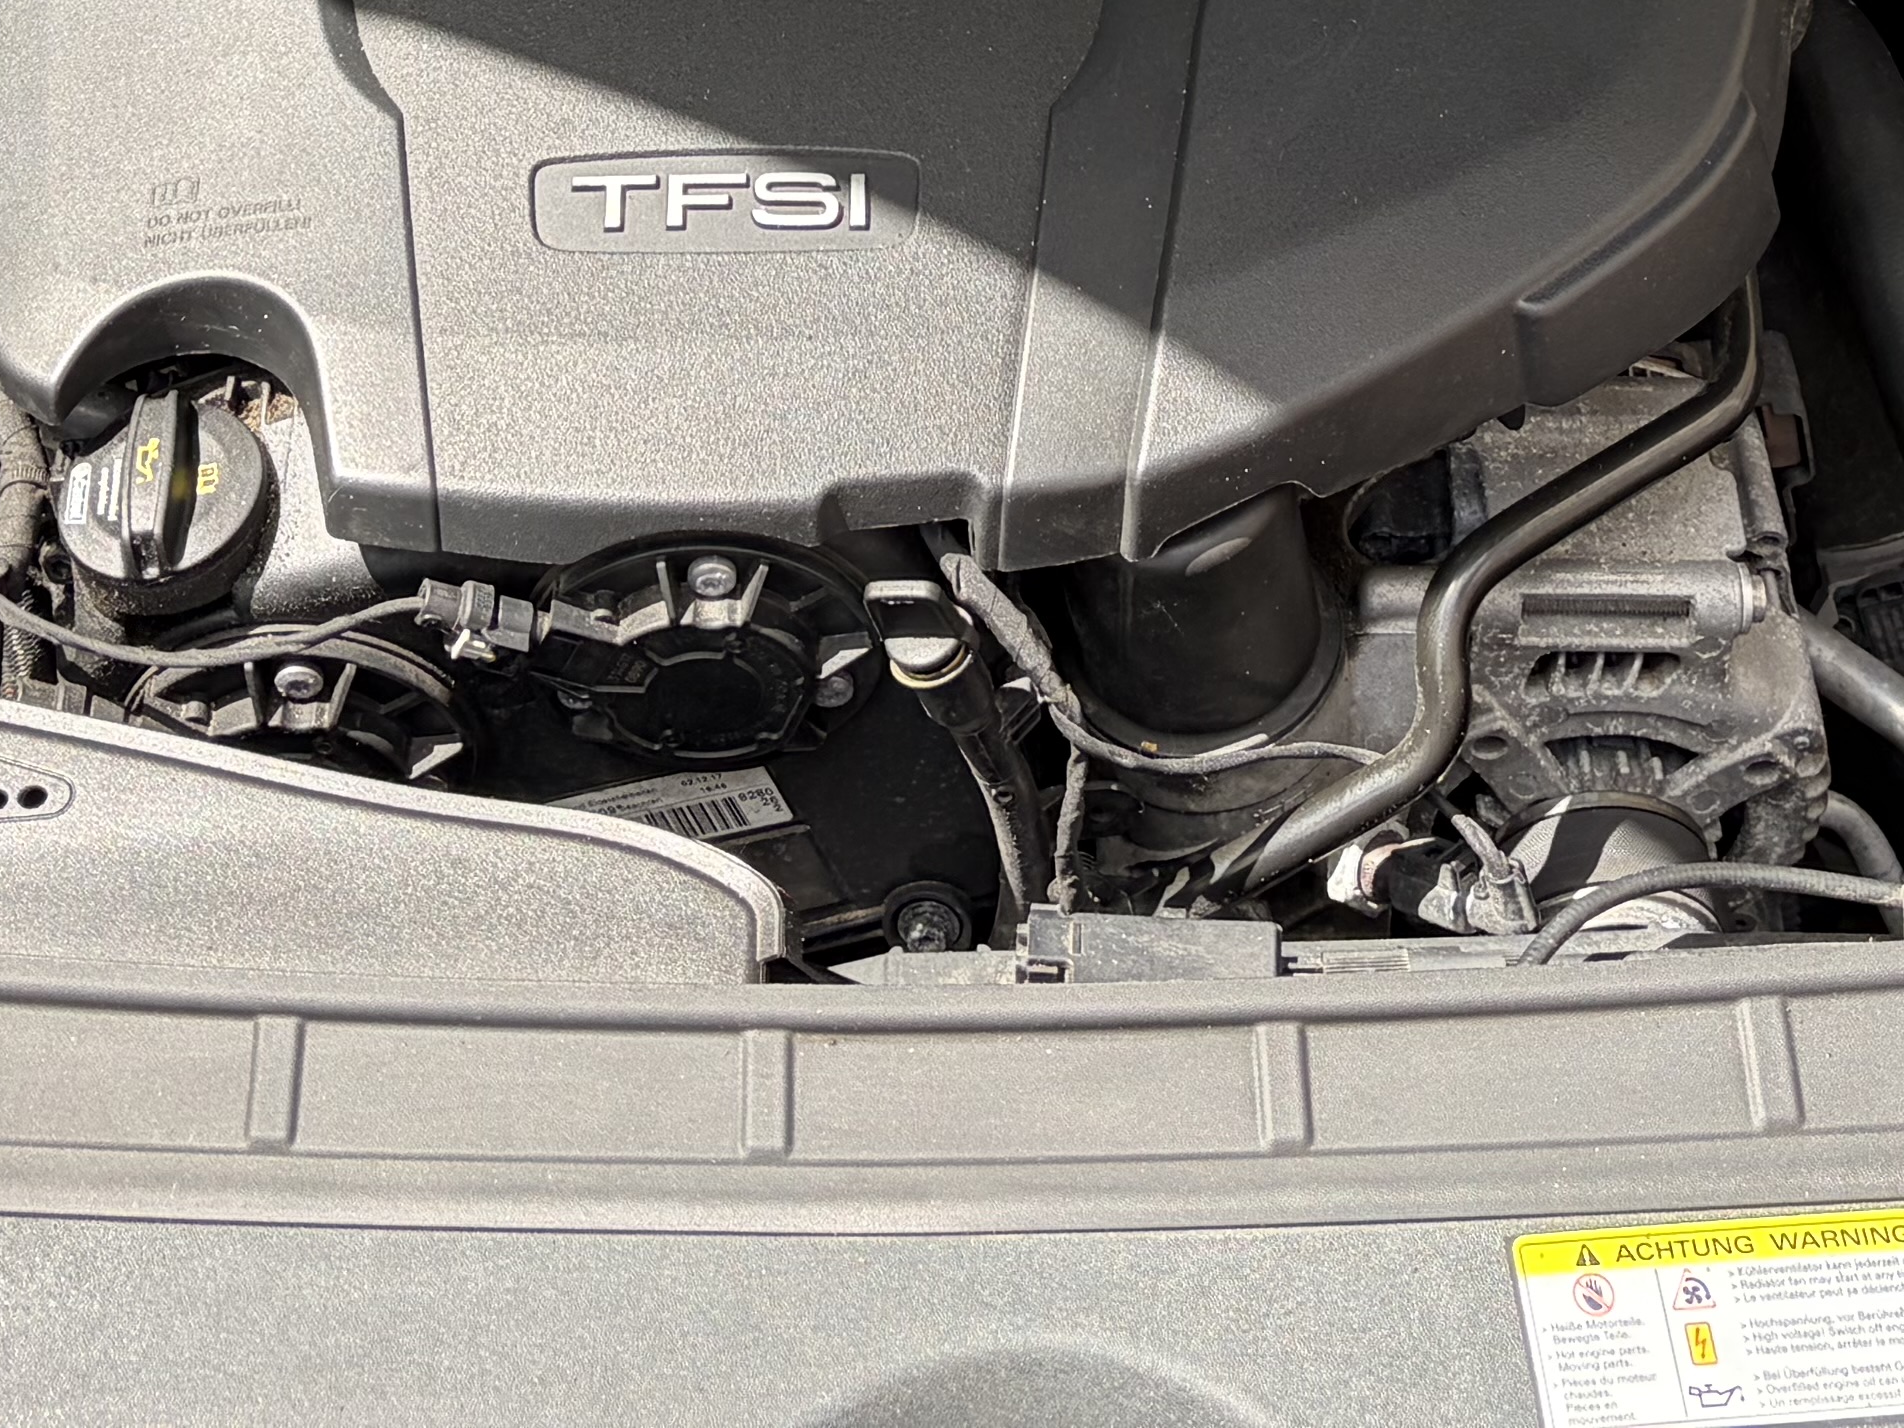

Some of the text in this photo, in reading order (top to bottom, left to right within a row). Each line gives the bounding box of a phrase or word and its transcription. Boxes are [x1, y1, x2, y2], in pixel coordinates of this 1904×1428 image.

[571, 171, 870, 232] TFSI
[146, 214, 171, 230] DO
[177, 207, 213, 225] NOT
[144, 229, 197, 249] NICHT
[1615, 1235, 1755, 1263] ACHTUNG
[1740, 1275, 1786, 1289] Radiator
[1835, 1270, 1860, 1283] start
